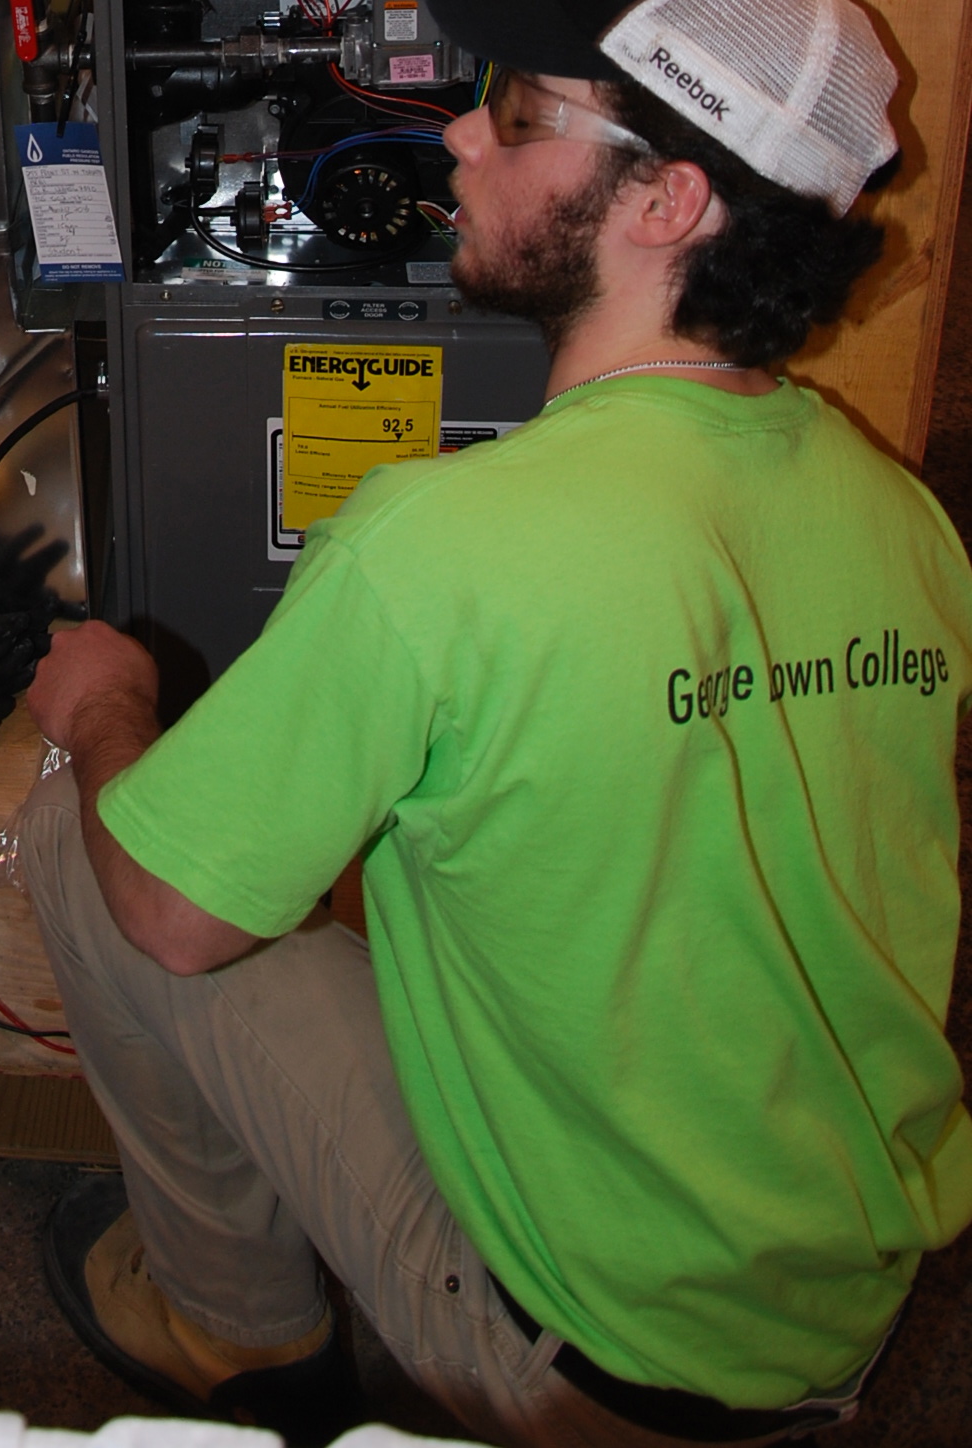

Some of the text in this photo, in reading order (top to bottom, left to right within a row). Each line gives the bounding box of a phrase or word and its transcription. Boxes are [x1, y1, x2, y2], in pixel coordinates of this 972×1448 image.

[649, 47, 730, 122] Reebok
[382, 418, 414, 432] 92.5
[845, 628, 949, 696] College
